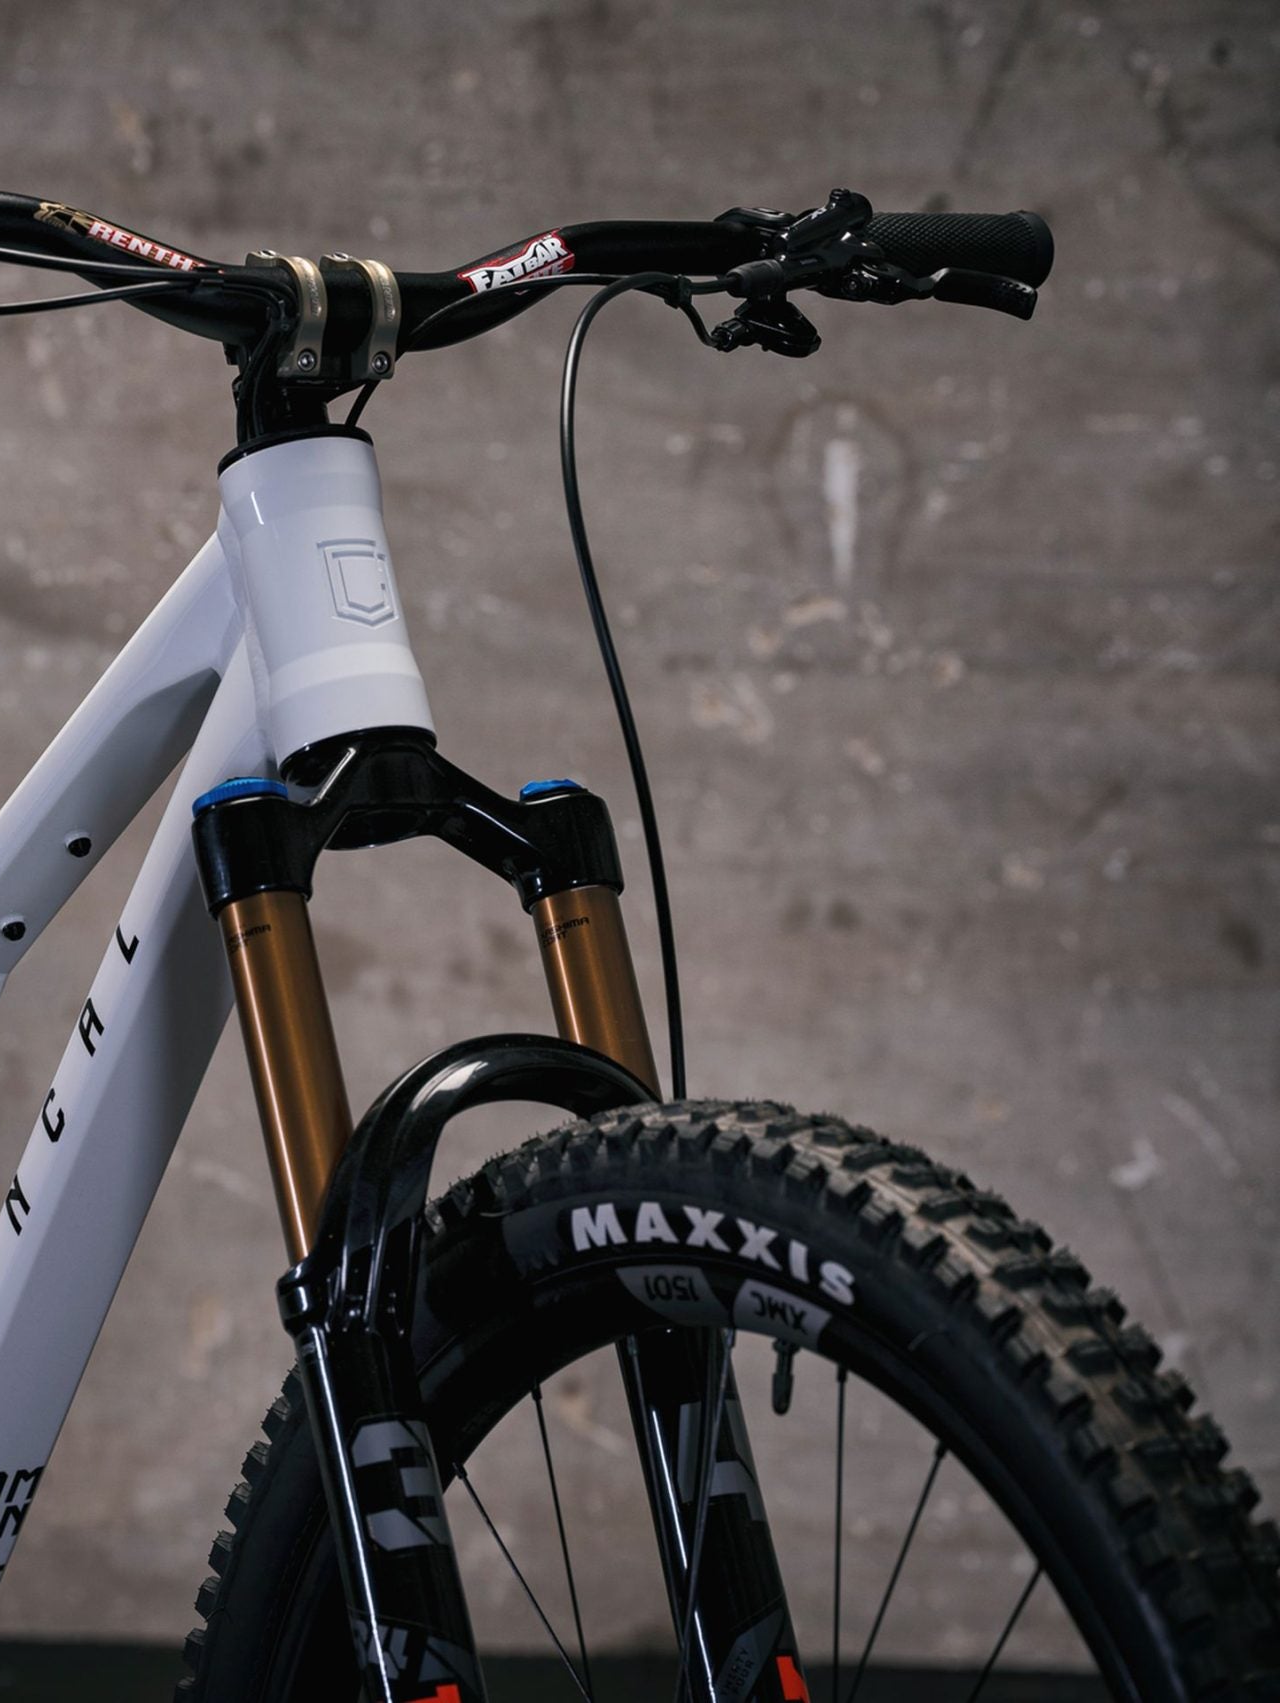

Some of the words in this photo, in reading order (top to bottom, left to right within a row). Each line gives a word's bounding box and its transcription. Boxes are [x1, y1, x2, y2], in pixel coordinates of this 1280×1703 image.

[571, 1202, 856, 1305] MAXXIS
[645, 1274, 696, 1302] 1501
[755, 1291, 808, 1336] XMC
